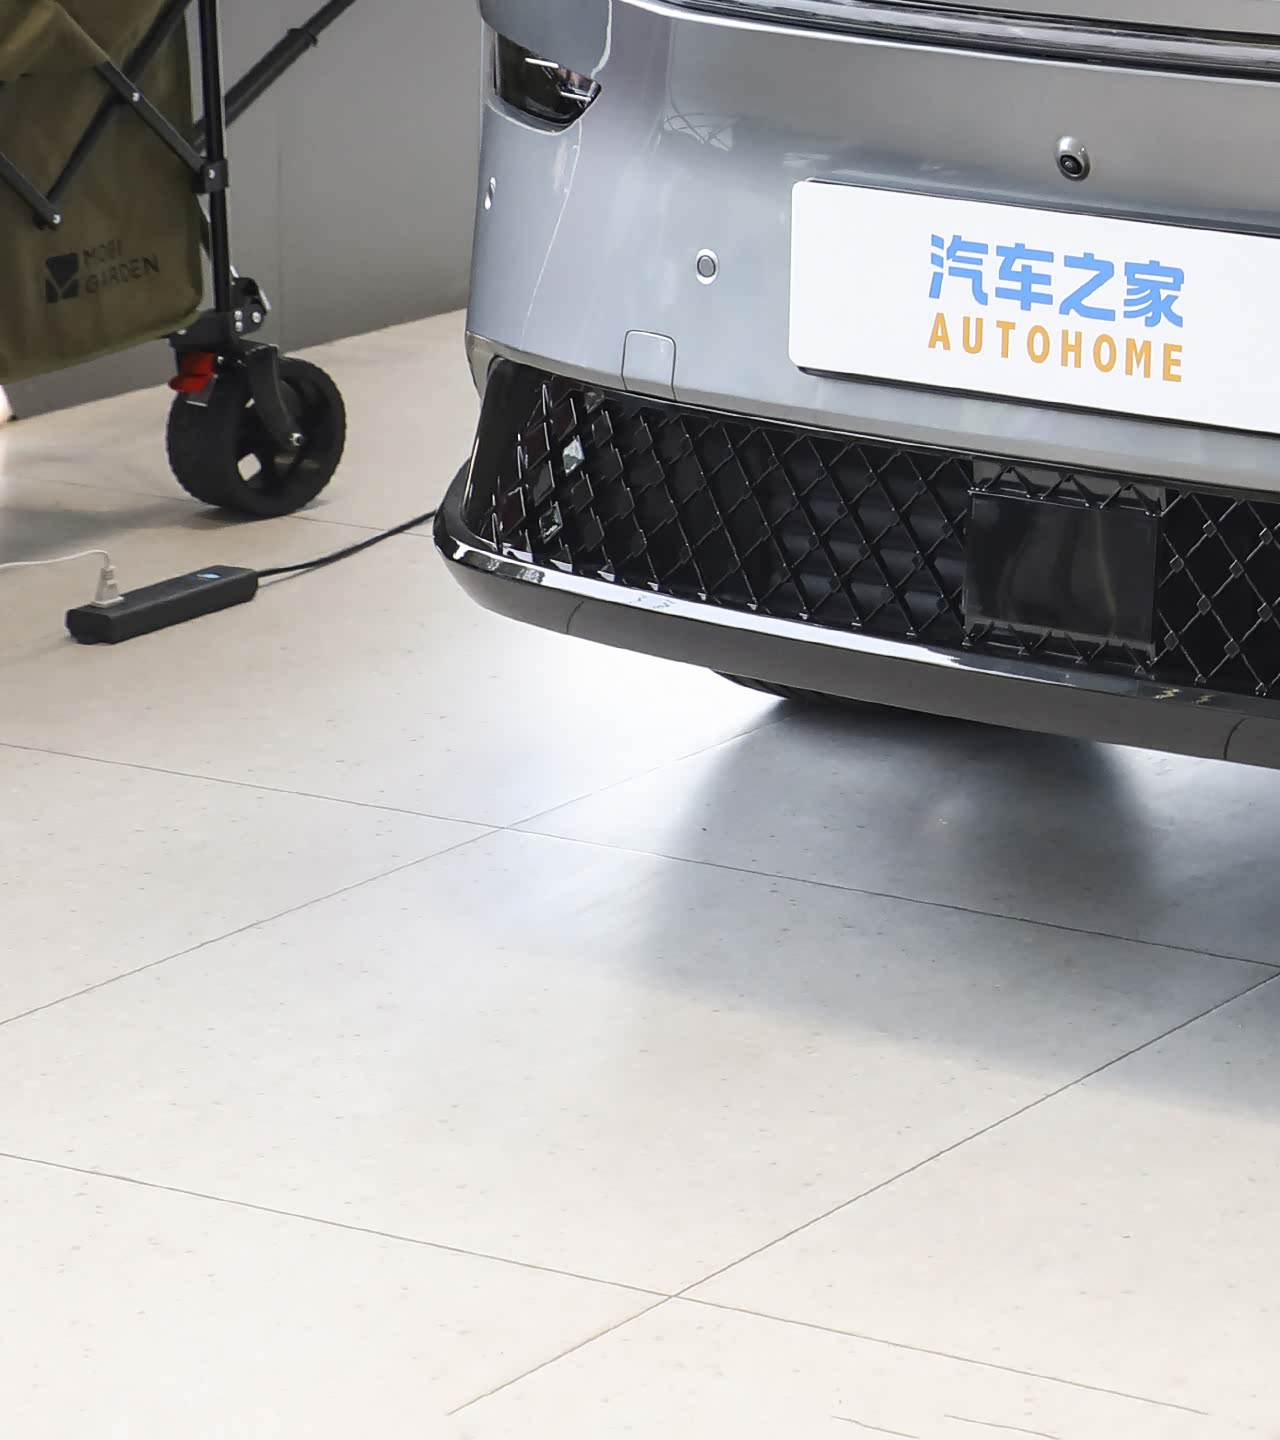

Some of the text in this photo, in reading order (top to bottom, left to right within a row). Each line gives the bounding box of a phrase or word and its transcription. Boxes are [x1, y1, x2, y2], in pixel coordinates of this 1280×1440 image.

[929, 235, 1184, 327] 汽车之家
[929, 312, 1183, 383] AUTOHOME
